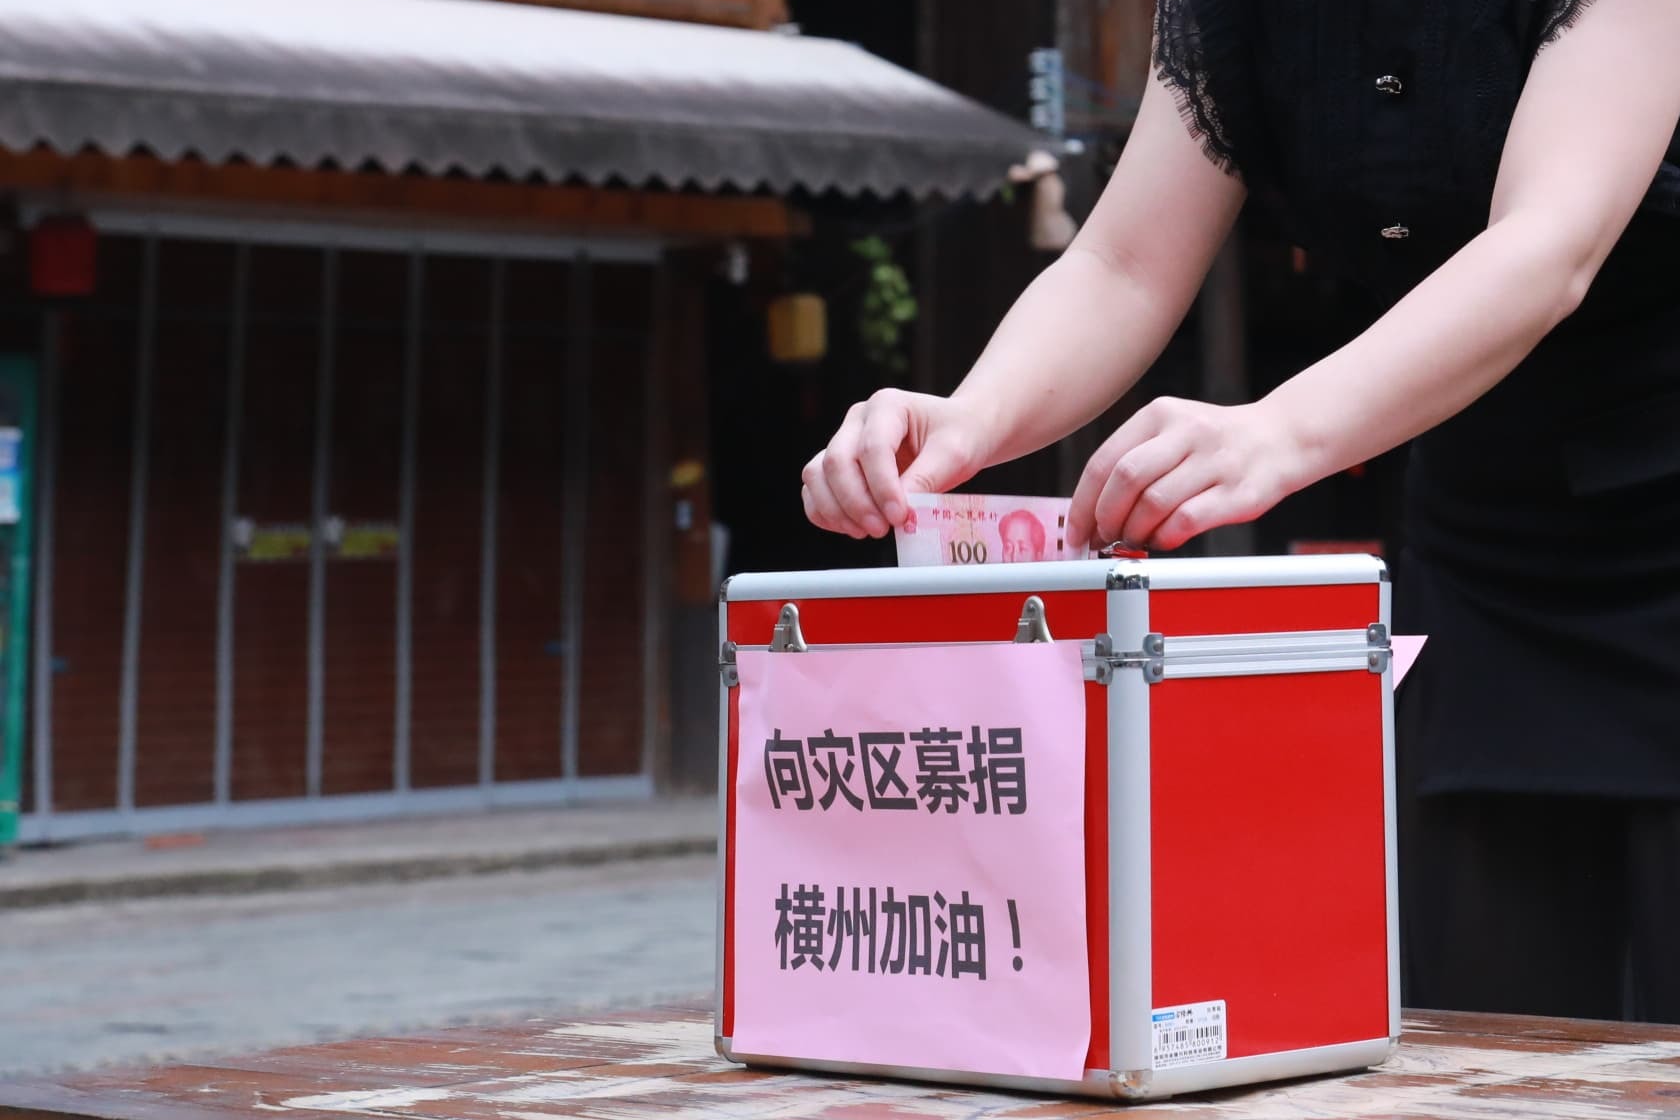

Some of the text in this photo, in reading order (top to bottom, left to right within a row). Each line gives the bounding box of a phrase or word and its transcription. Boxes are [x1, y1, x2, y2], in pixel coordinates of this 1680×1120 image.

[949, 540, 987, 565] 100
[764, 725, 1028, 815] 向灾区募捐
[774, 883, 1024, 981] 横州加油！
